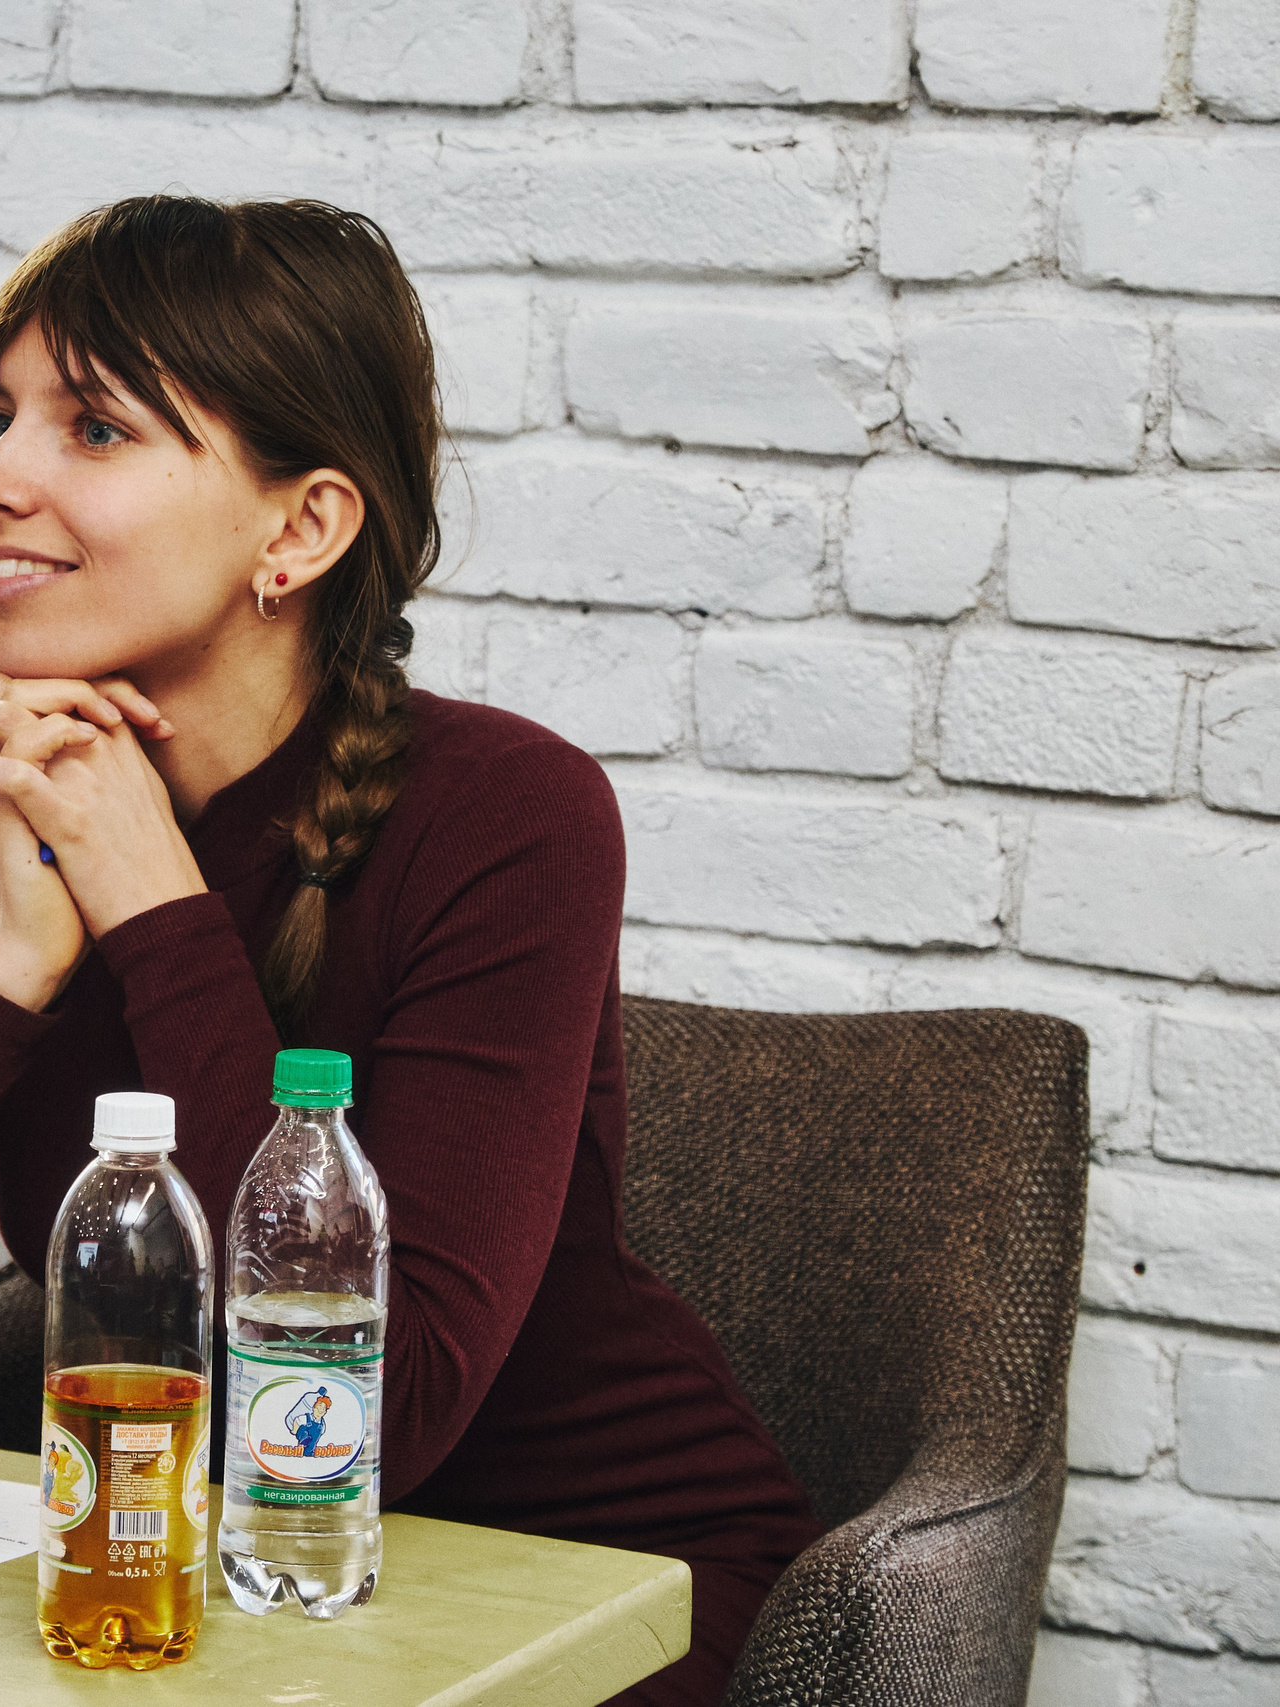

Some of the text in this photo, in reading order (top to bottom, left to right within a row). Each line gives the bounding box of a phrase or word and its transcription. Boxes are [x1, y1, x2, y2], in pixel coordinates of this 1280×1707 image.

[116, 1431, 168, 1439] ДОСТАВКУ ВОДЫ
[260, 1439, 353, 1458] Веселый водовоз
[263, 1491, 345, 1503] негазированная
[125, 1566, 140, 1579] 0,5
